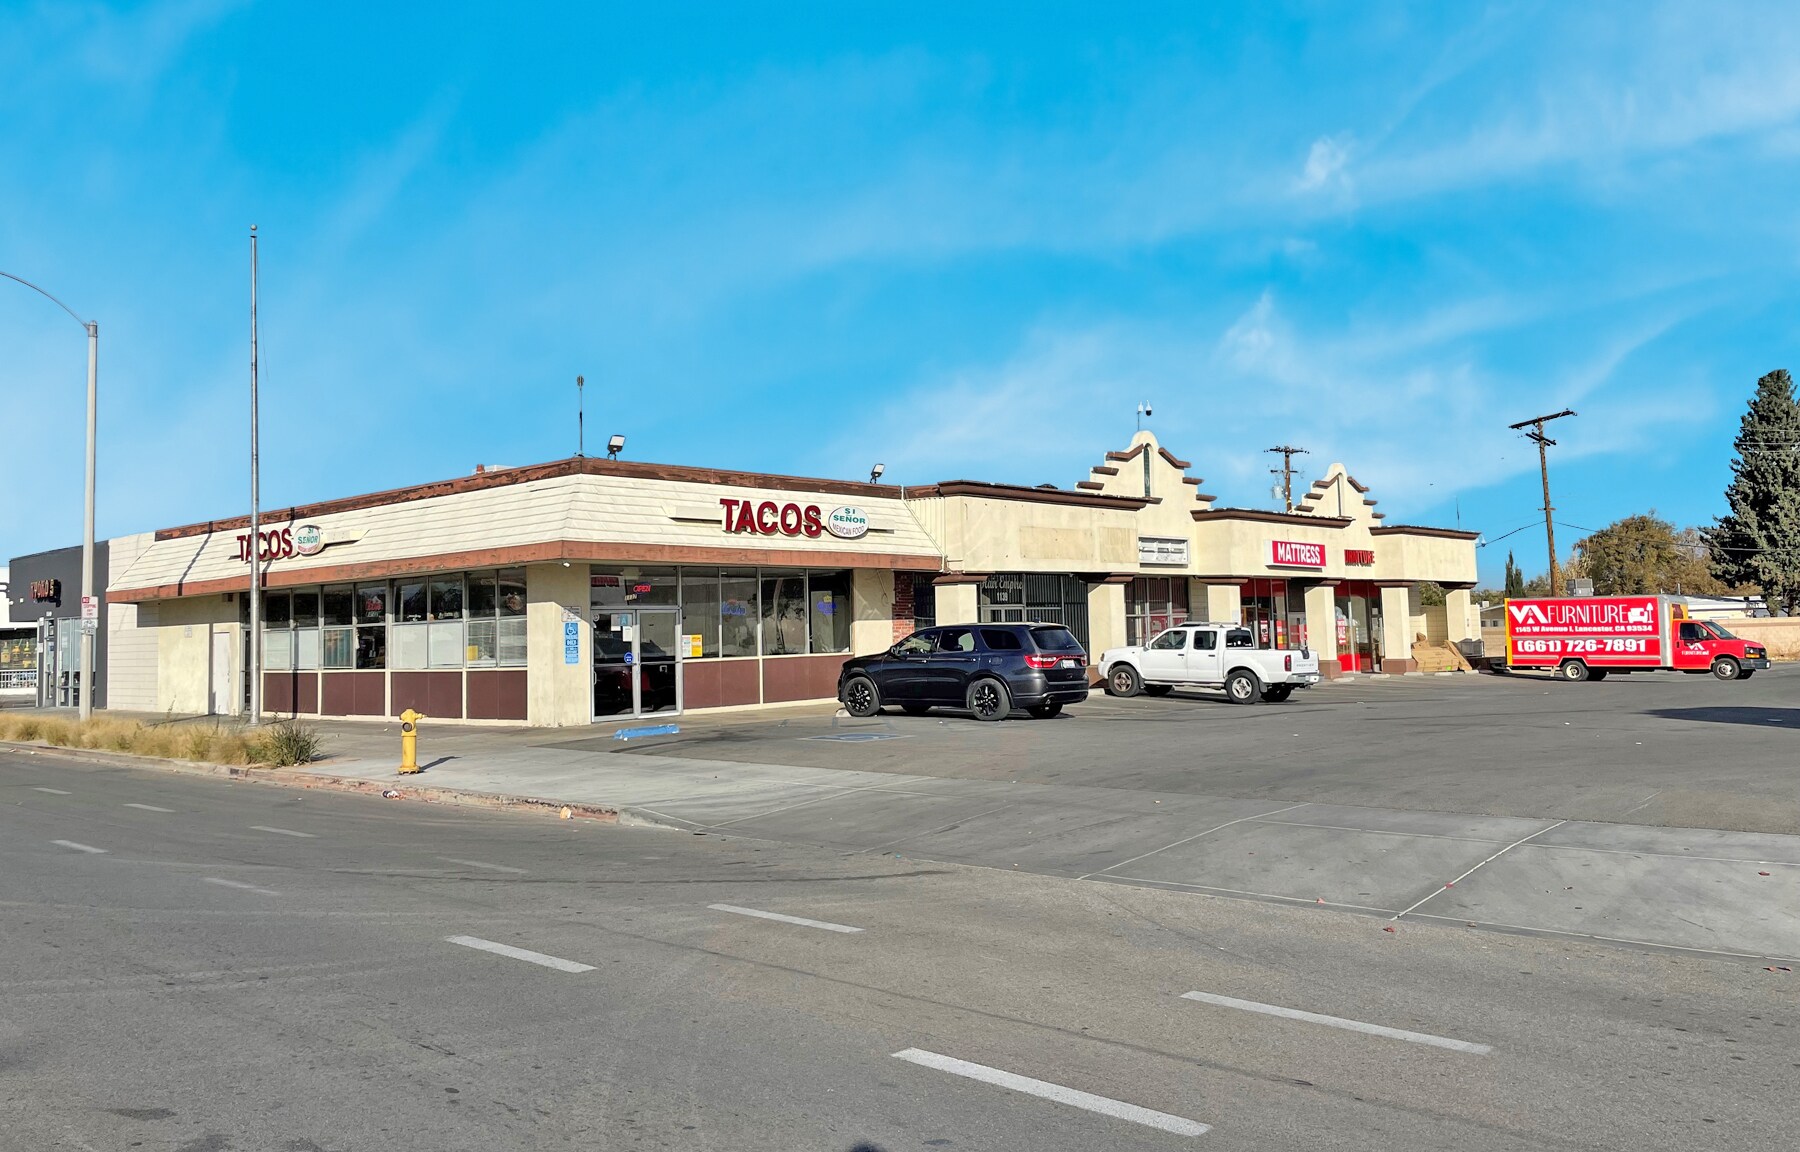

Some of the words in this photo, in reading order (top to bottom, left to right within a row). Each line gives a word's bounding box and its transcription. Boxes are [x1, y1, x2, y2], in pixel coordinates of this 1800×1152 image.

[720, 498, 822, 537] TACOS
[832, 522, 852, 536] MEXICAN
[852, 525, 865, 535] FOOD
[1277, 542, 1320, 564] MATTRESS
[633, 584, 652, 593] OPEN
[999, 575, 1023, 593] Empire
[1547, 604, 1629, 624] FURNITURE
[1517, 640, 1562, 652] (661)
[1565, 638, 1646, 652] 726-7891
